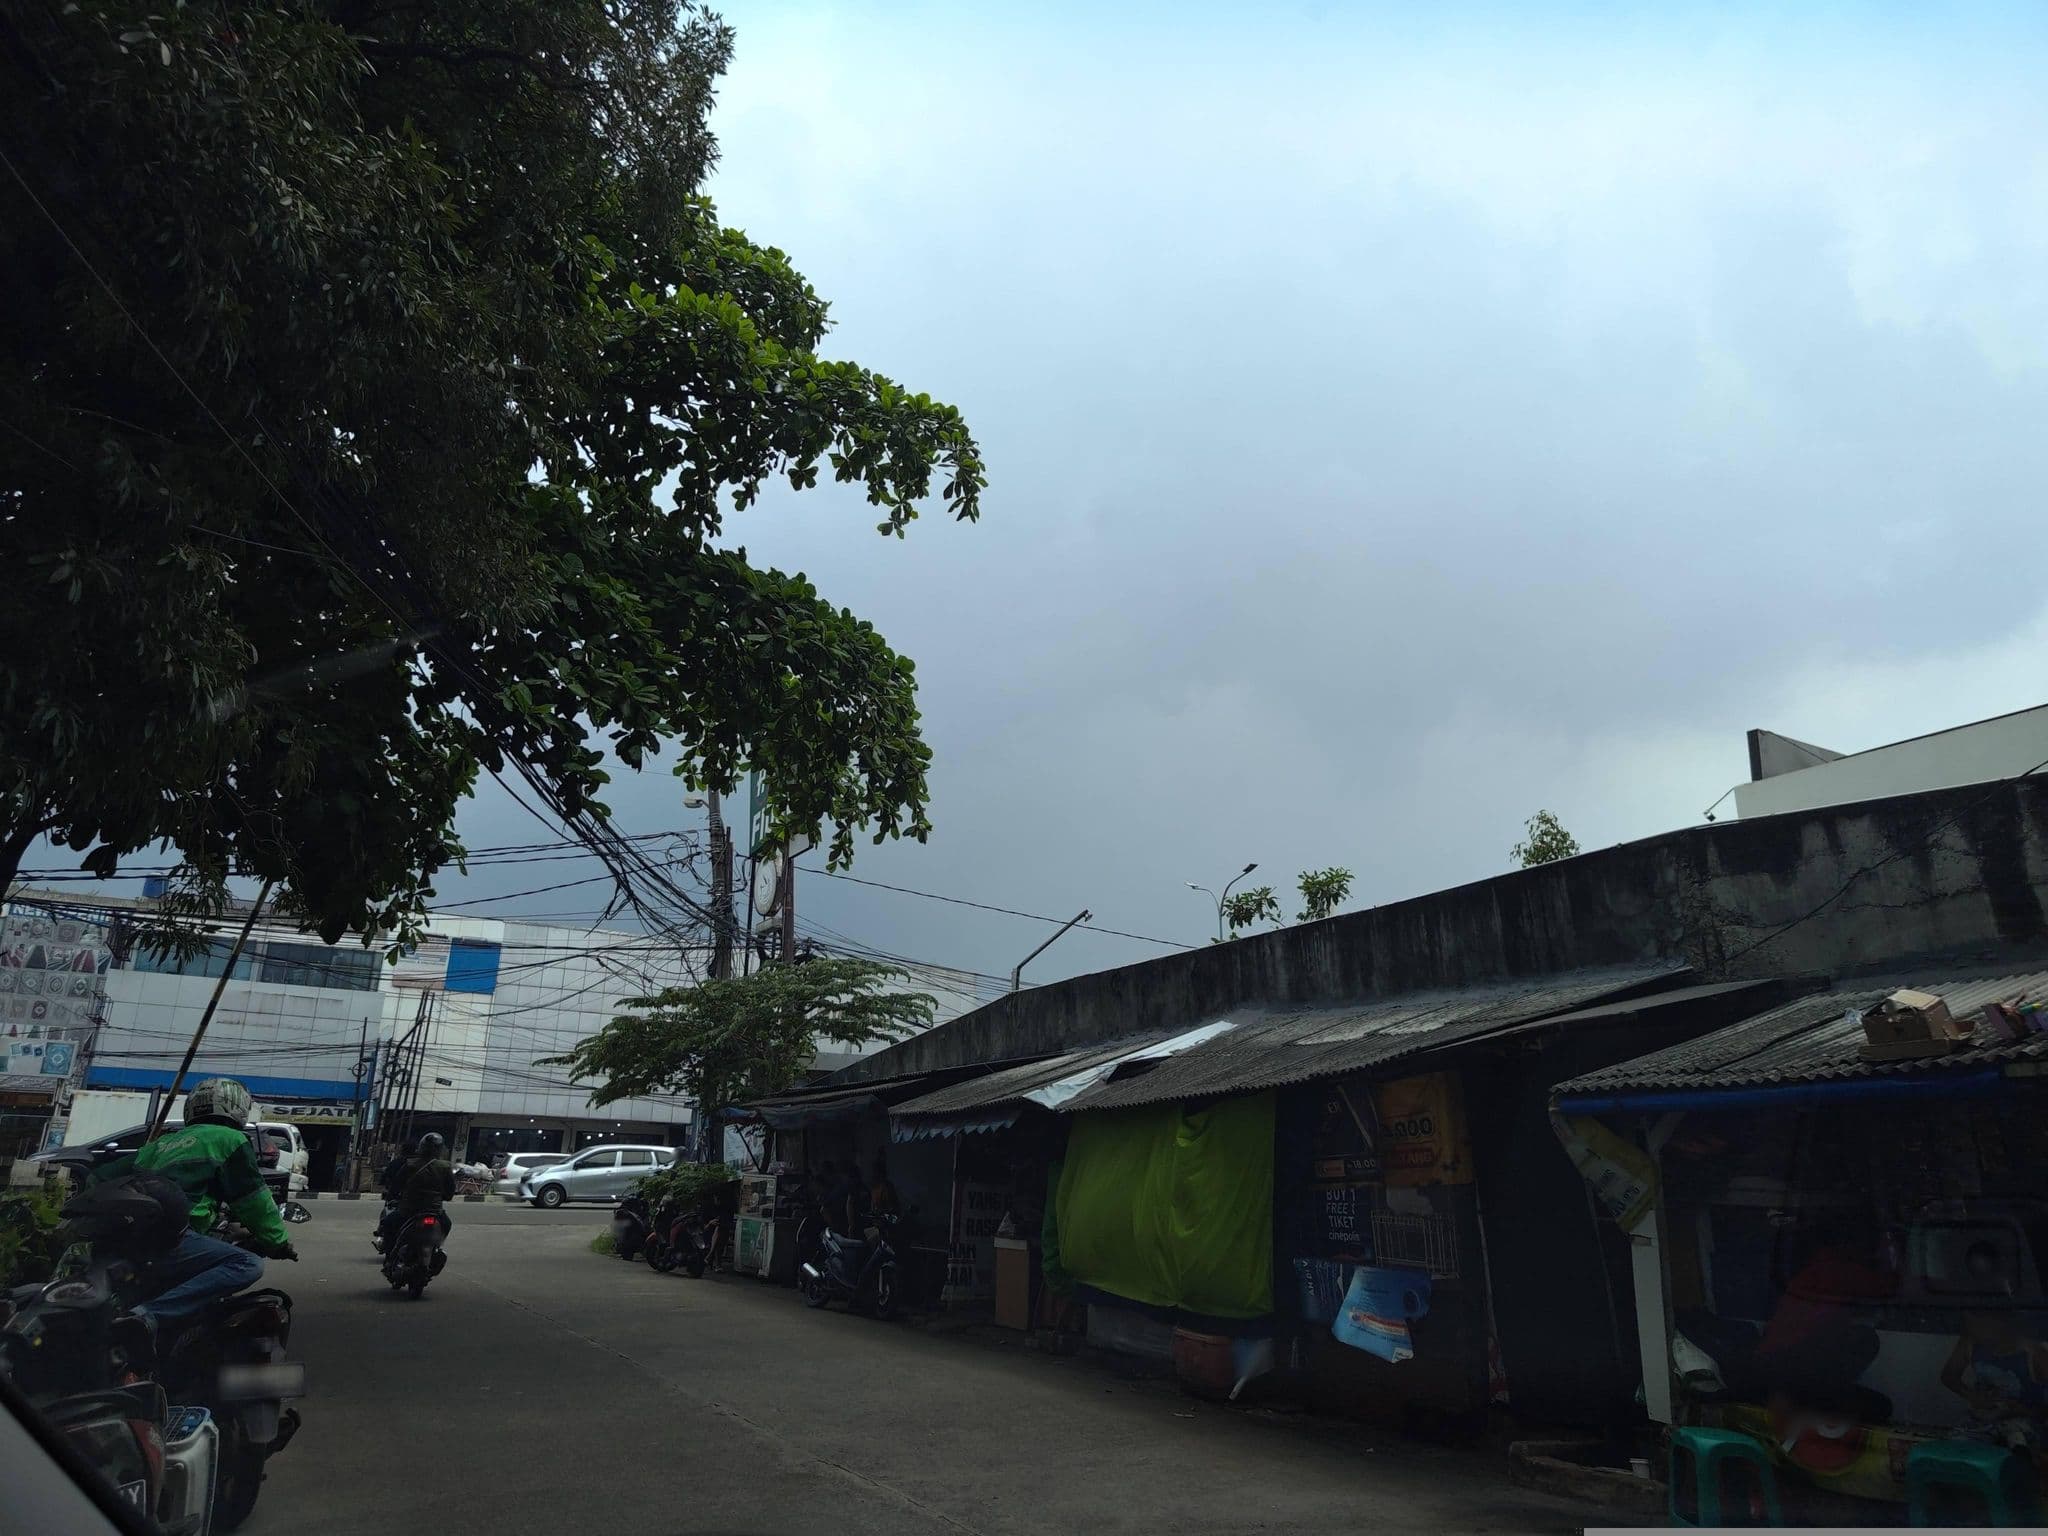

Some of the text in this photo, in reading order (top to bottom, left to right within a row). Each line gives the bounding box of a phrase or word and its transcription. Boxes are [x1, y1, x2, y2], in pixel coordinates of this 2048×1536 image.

[1326, 1188, 1345, 1200] BUY
[1326, 1202, 1348, 1215] FREE
[1328, 1215, 1354, 1229] TIKET
